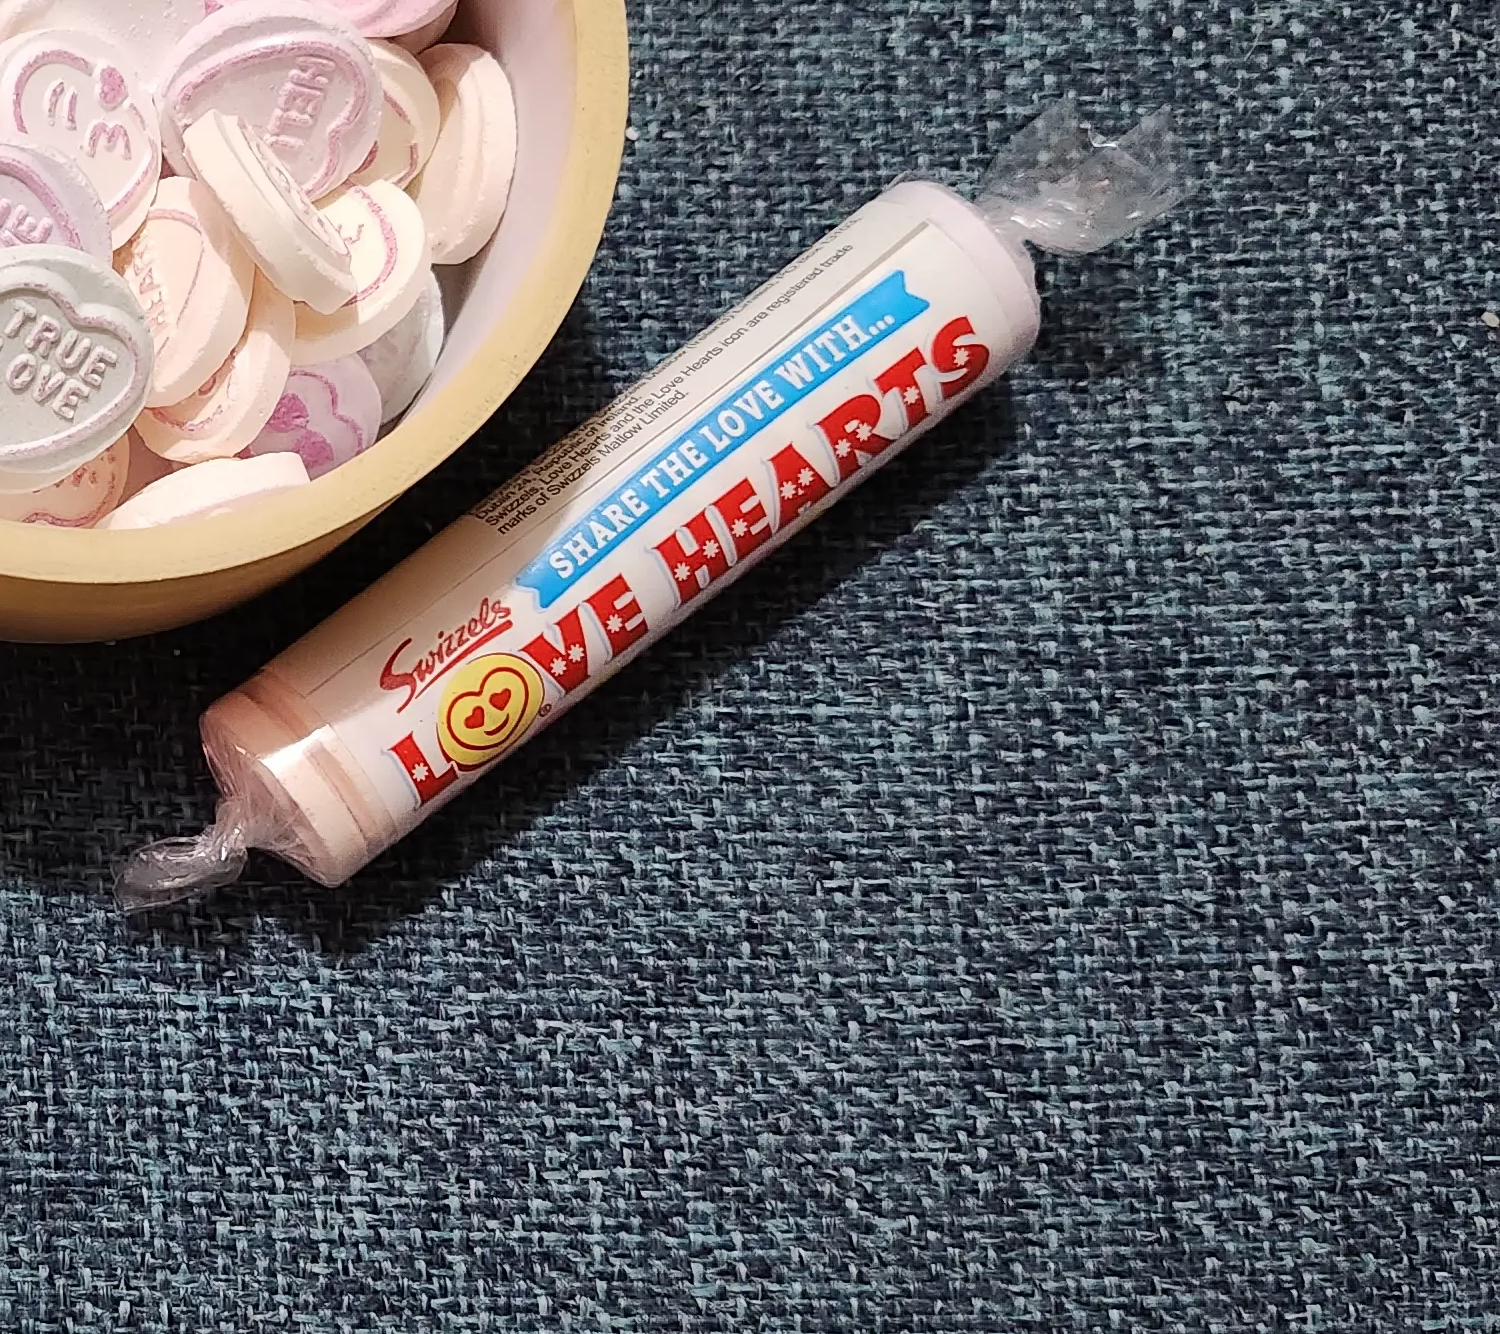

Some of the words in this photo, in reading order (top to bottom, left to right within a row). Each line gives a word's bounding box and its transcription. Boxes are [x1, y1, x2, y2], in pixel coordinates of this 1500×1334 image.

[3, 299, 119, 386] TRUE
[485, 479, 544, 528] Swizzels,
[538, 457, 572, 487] Love
[568, 427, 612, 465] Hearts
[608, 410, 635, 433] and
[631, 395, 654, 416] the
[650, 372, 684, 401] Love
[680, 342, 724, 379] Hearts
[718, 323, 749, 349] icon
[745, 308, 768, 329] are
[764, 264, 825, 315] registered
[819, 241, 853, 270] trade
[496, 501, 537, 536] marks
[532, 490, 550, 508] of
[546, 451, 601, 498] Swizzels
[598, 420, 643, 457] Matlow
[638, 384, 688, 426] Limited.
[533, 434, 587, 478] Republic
[584, 425, 599, 438] of
[596, 391, 642, 429] Ireland.
[547, 487, 648, 579] SHARE
[640, 441, 709, 501] THE
[698, 379, 786, 451] LOVE
[776, 313, 895, 390] WITH...
[389, 572, 649, 802] LOVE
[652, 316, 991, 606] HEARTS
[380, 597, 513, 714] Swizzels
